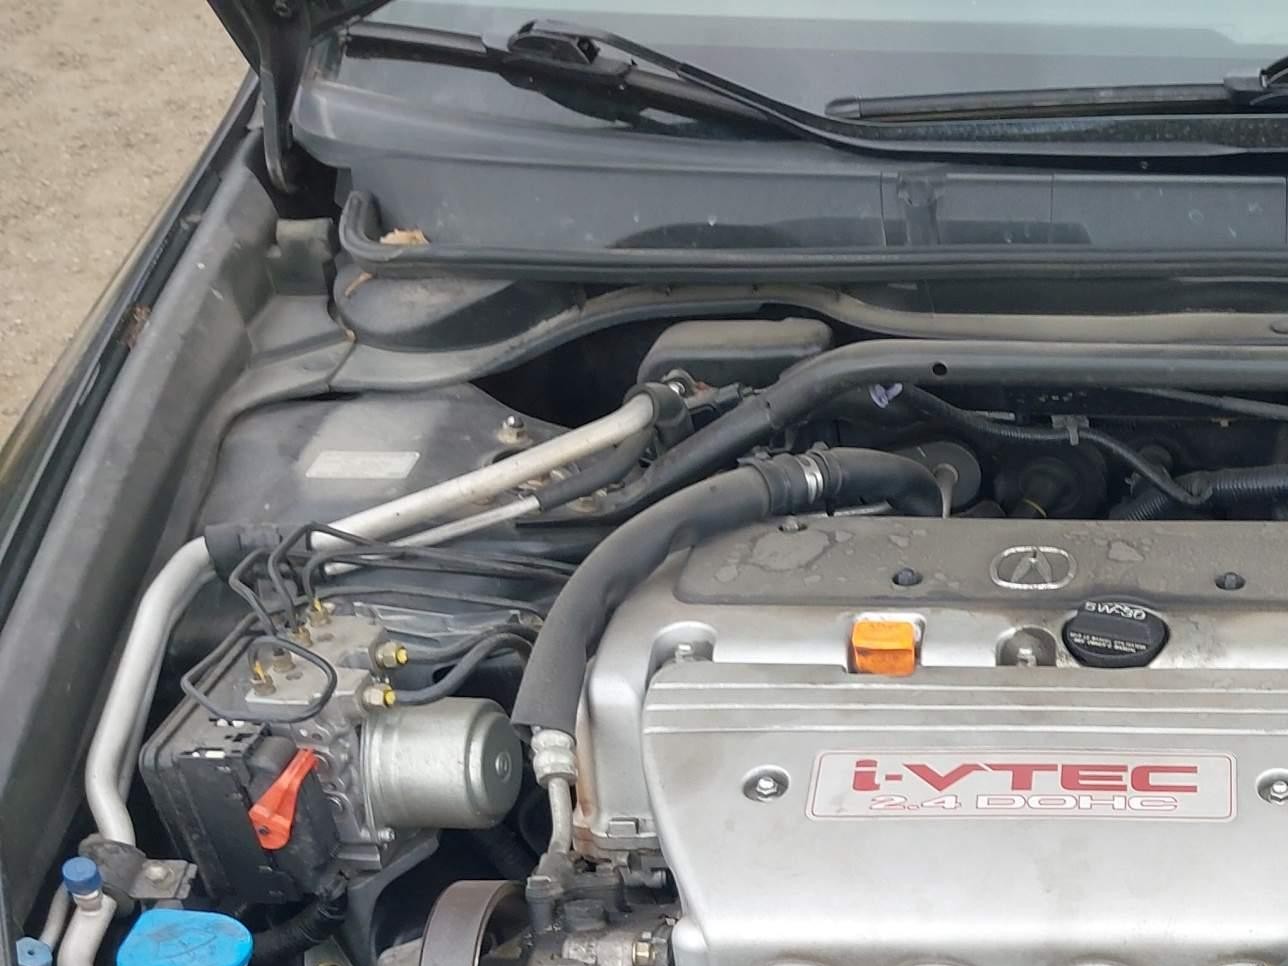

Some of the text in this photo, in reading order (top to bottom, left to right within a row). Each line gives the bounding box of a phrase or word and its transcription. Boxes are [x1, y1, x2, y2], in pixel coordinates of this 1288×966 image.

[1085, 601, 1147, 620] 5W-30
[852, 759, 1198, 793] i-VTEC
[869, 794, 1178, 811] 2.4 DOHC
